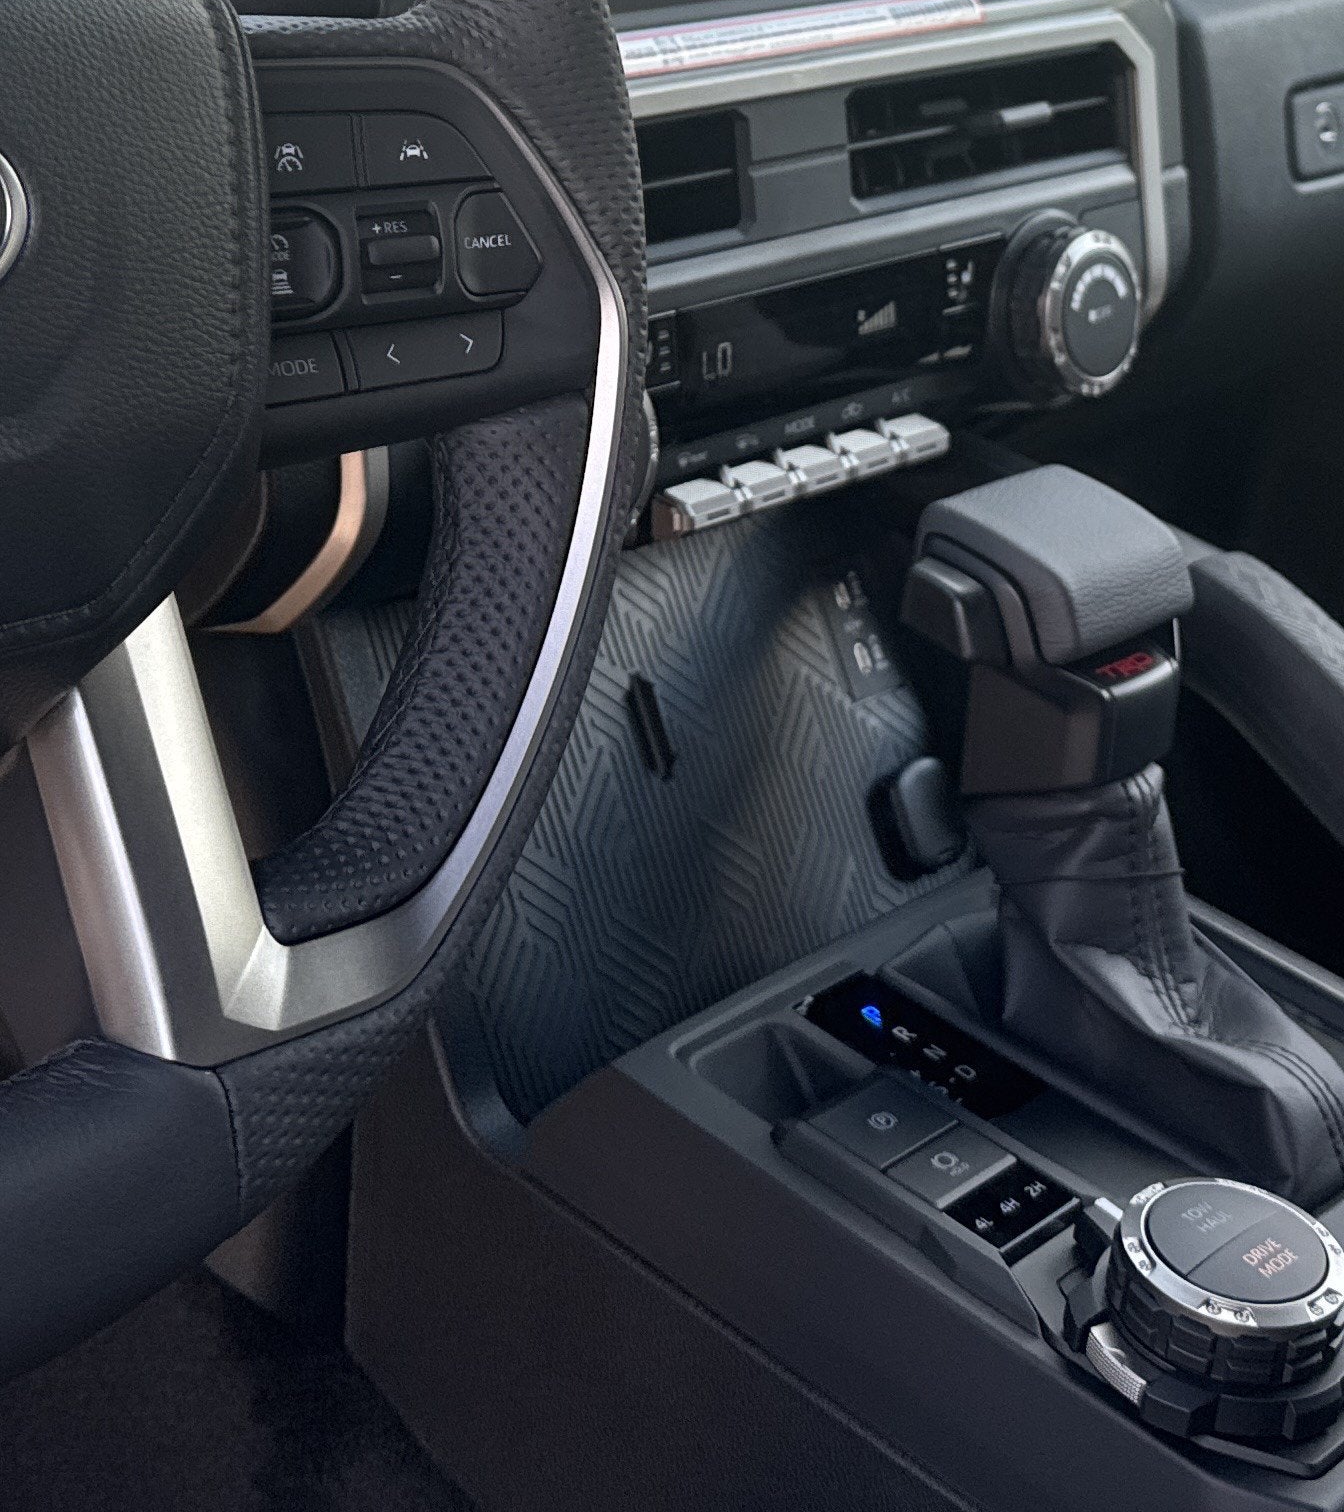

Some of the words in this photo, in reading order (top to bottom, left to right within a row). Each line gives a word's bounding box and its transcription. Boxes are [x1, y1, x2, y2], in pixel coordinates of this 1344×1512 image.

[464, 234, 511, 250] CANCEL
[892, 1026, 917, 1042] R
[1242, 1237, 1282, 1266] DRIVE
[1258, 1247, 1299, 1279] MODE
